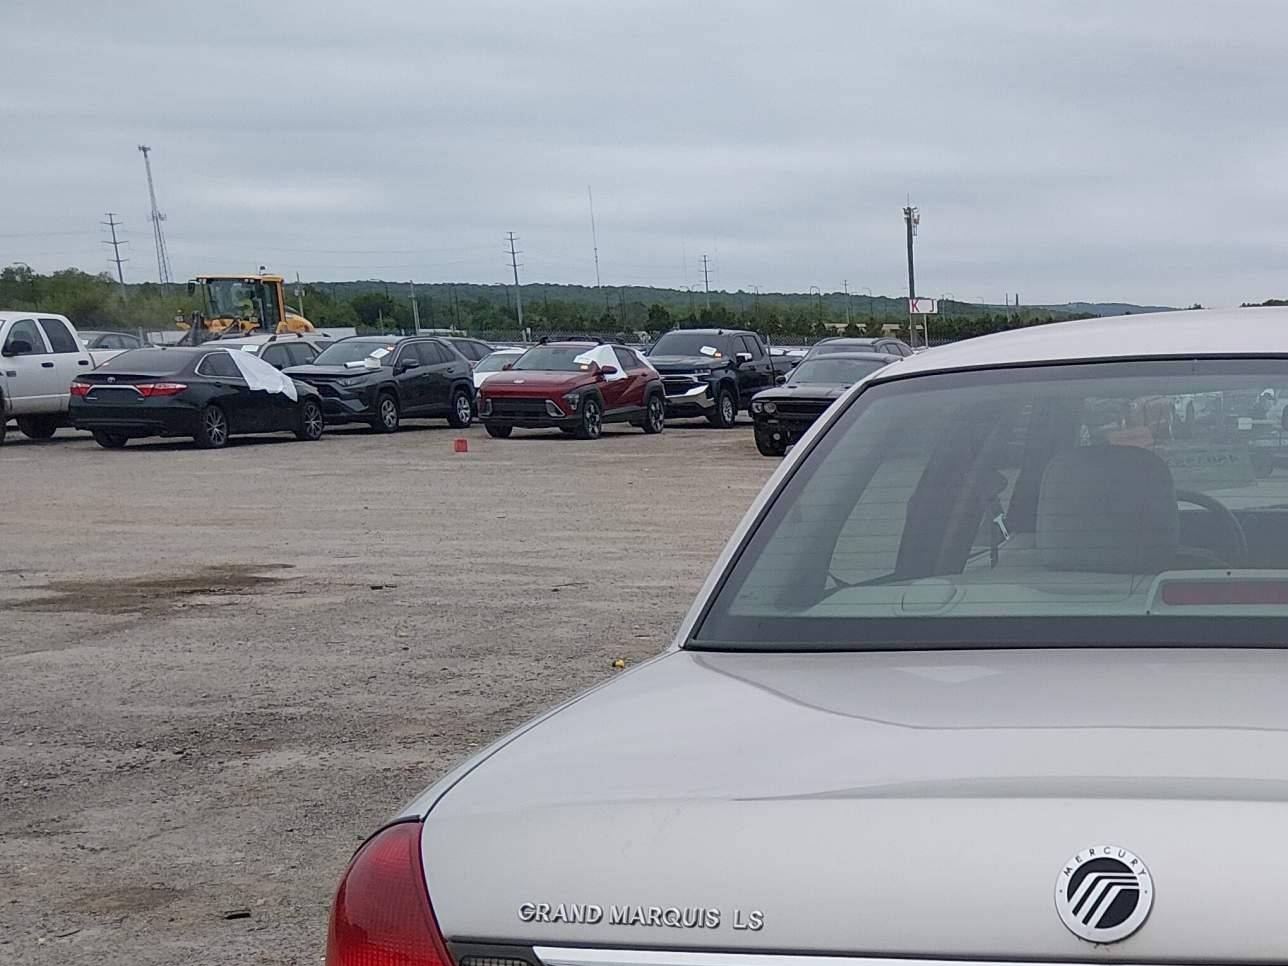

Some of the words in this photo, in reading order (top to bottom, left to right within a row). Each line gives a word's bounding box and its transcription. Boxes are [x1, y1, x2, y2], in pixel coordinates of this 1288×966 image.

[911, 298, 920, 312] K
[929, 299, 935, 312] J
[1063, 846, 1147, 877] MERCURY
[518, 902, 604, 924] GRAND
[609, 904, 722, 929] MARQUIS
[733, 909, 765, 931] LS
